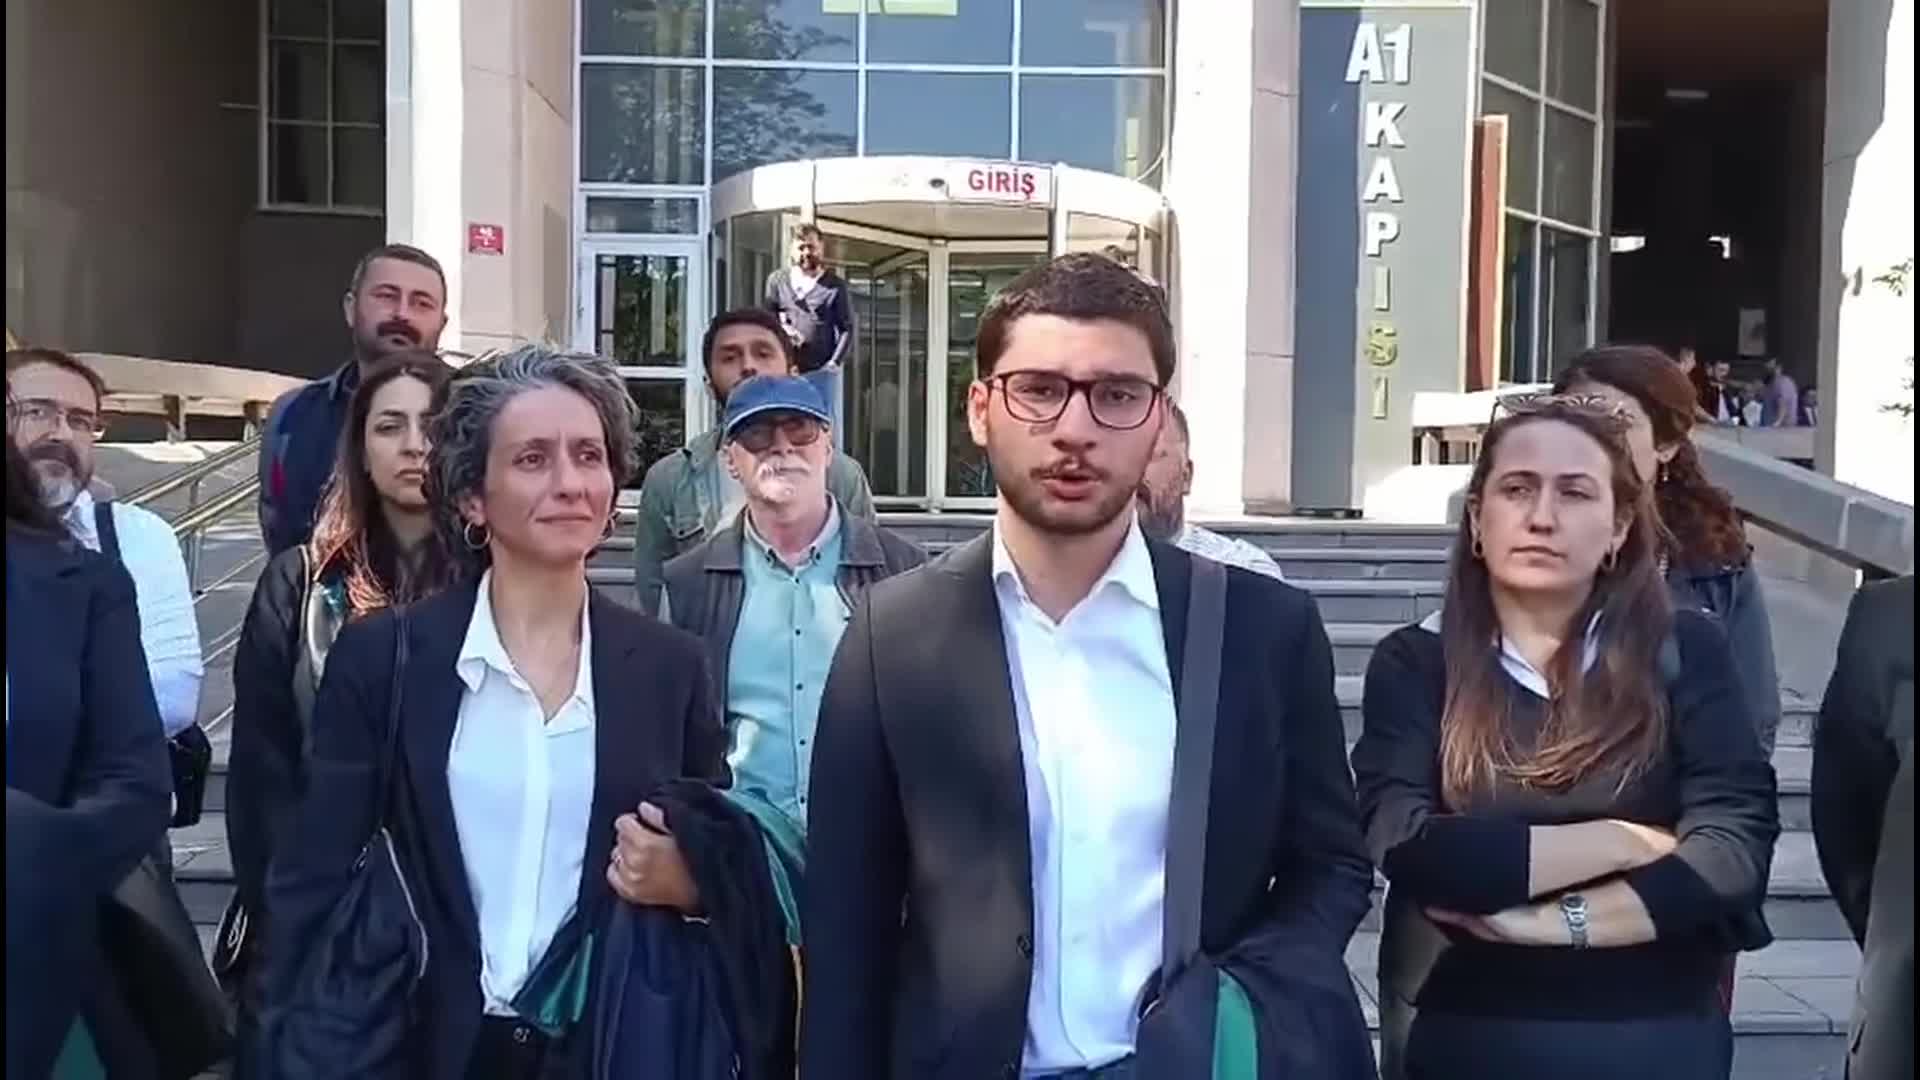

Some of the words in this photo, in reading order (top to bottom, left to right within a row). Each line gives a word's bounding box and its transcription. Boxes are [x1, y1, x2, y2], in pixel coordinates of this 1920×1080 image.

[1345, 22, 1411, 84] A1
[968, 166, 1035, 200] GİRİŞ
[1362, 101, 1406, 420] KAPISI
